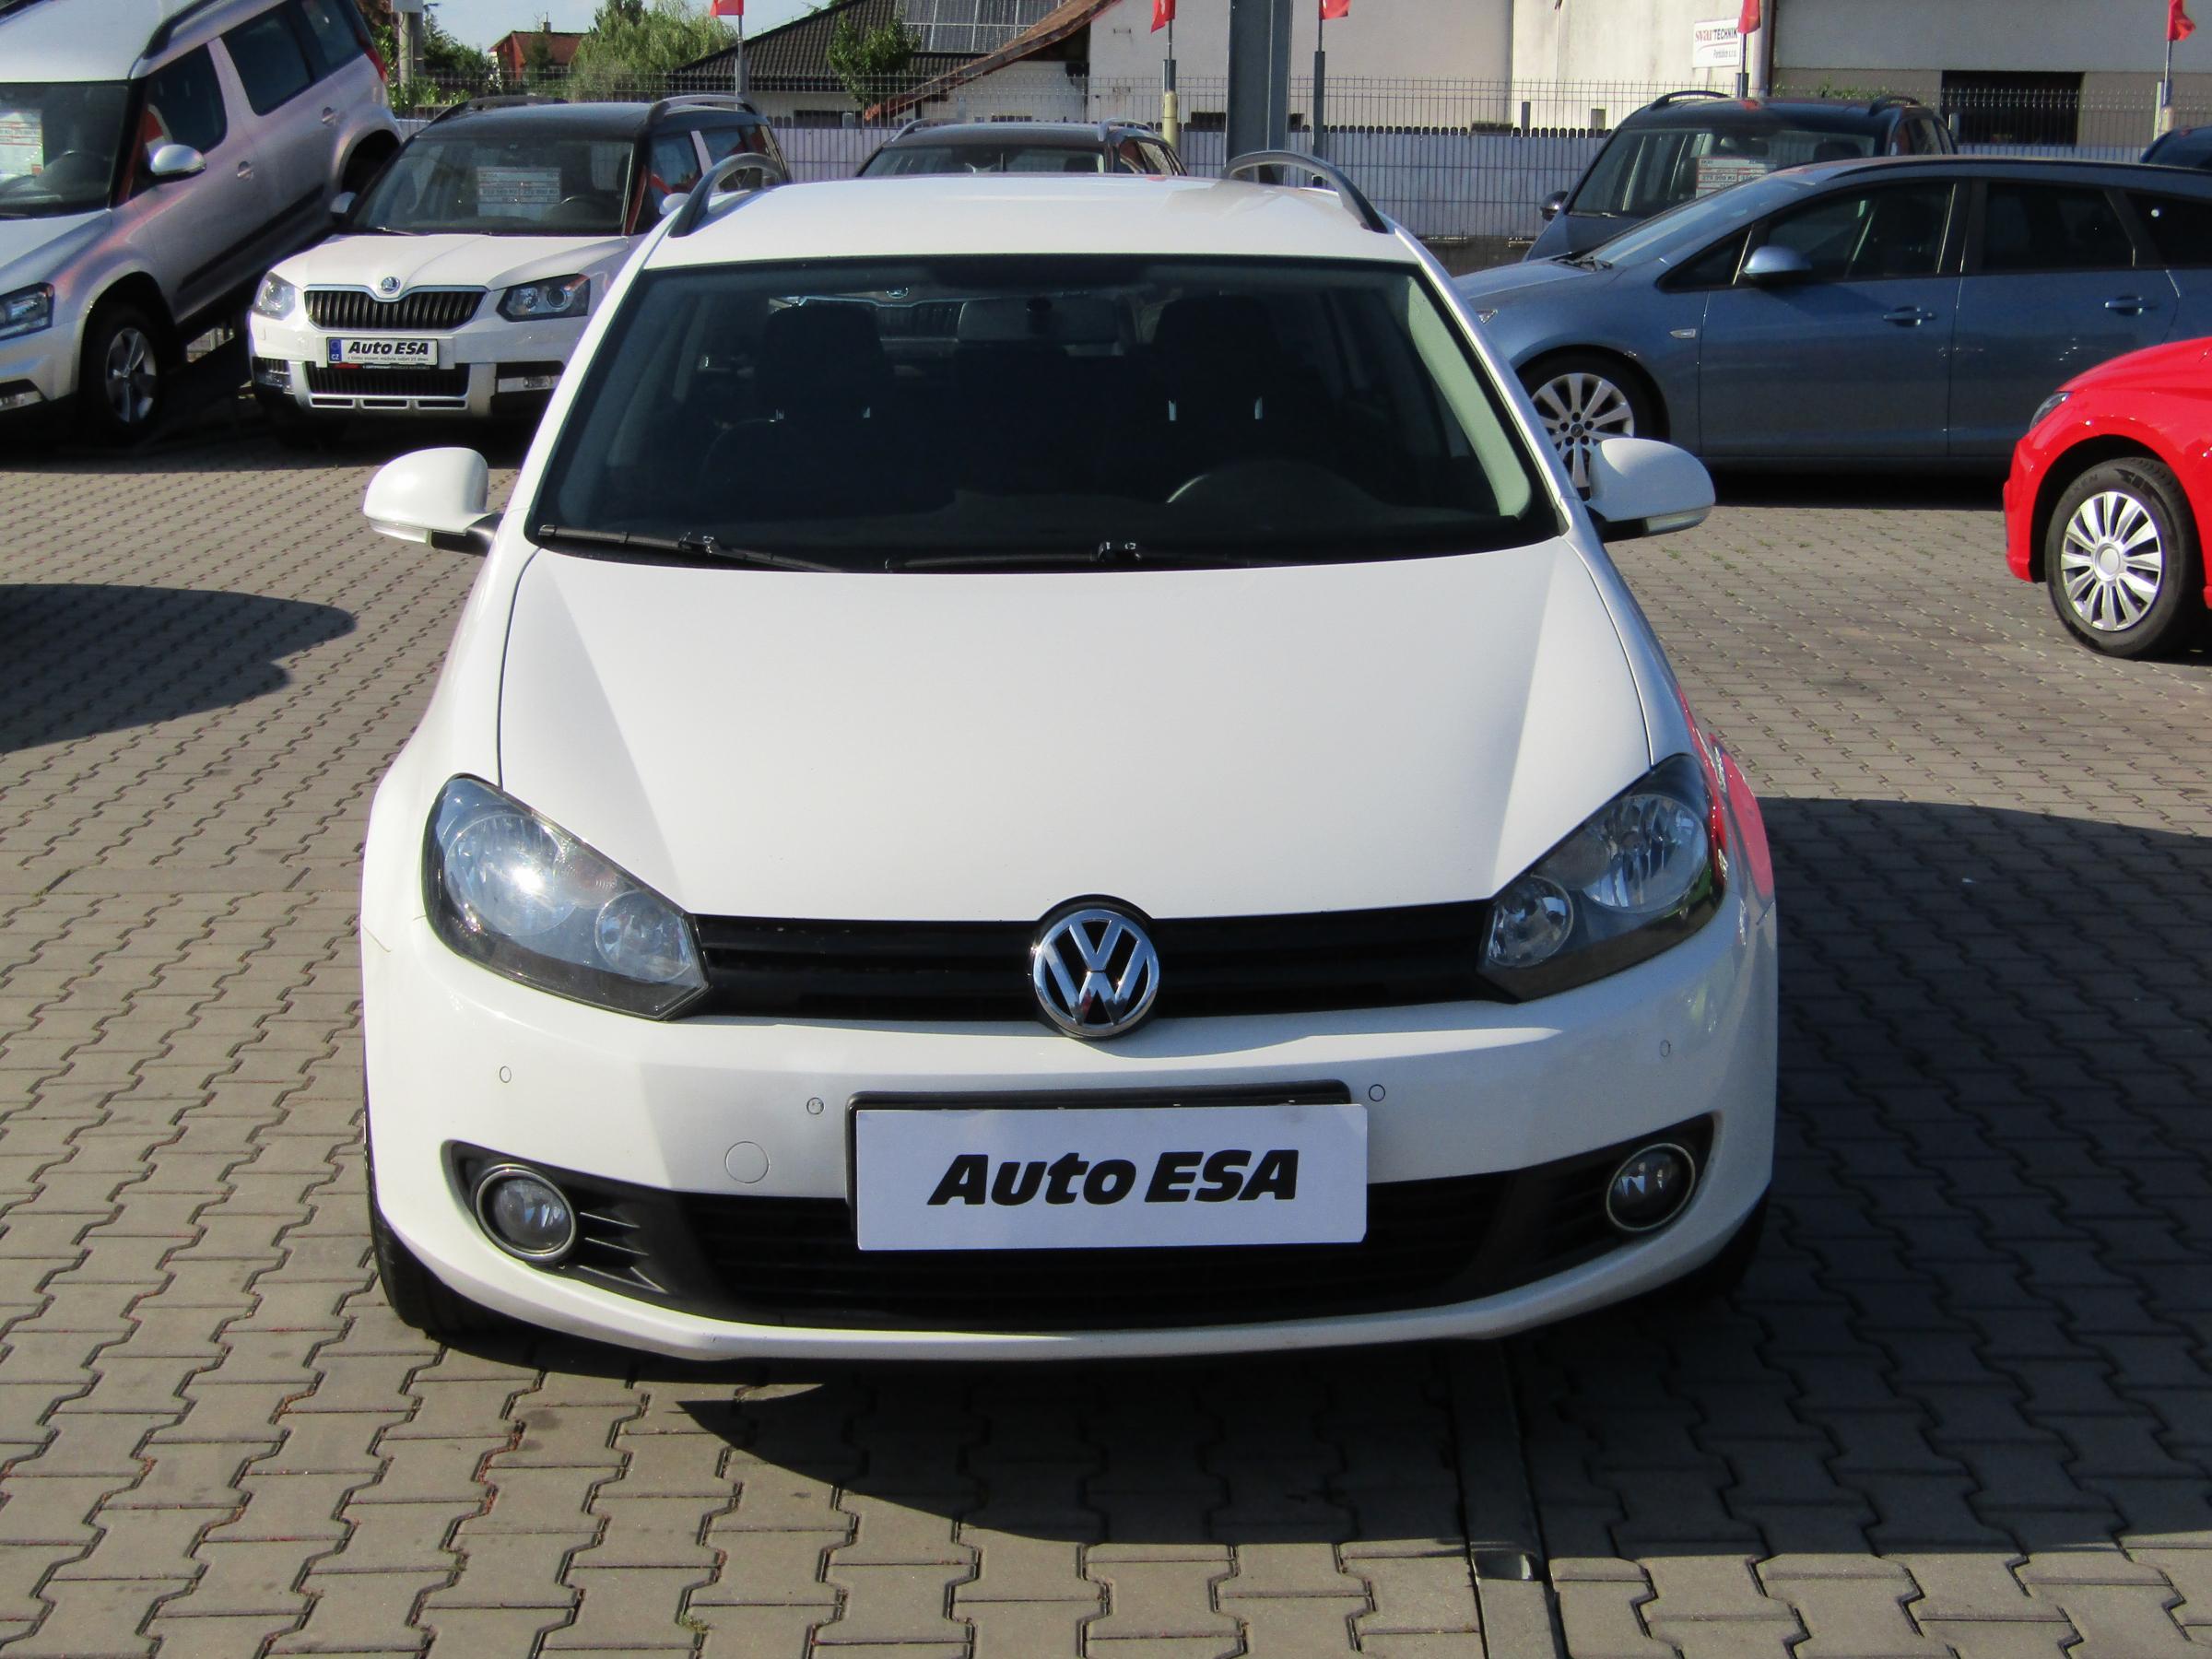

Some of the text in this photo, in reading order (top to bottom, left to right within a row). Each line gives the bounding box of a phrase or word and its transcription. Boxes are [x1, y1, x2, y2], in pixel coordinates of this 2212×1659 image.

[347, 341, 429, 355] Auto ESA
[1037, 912, 1156, 1032] VW
[927, 1148, 1300, 1206] Auto ESA
